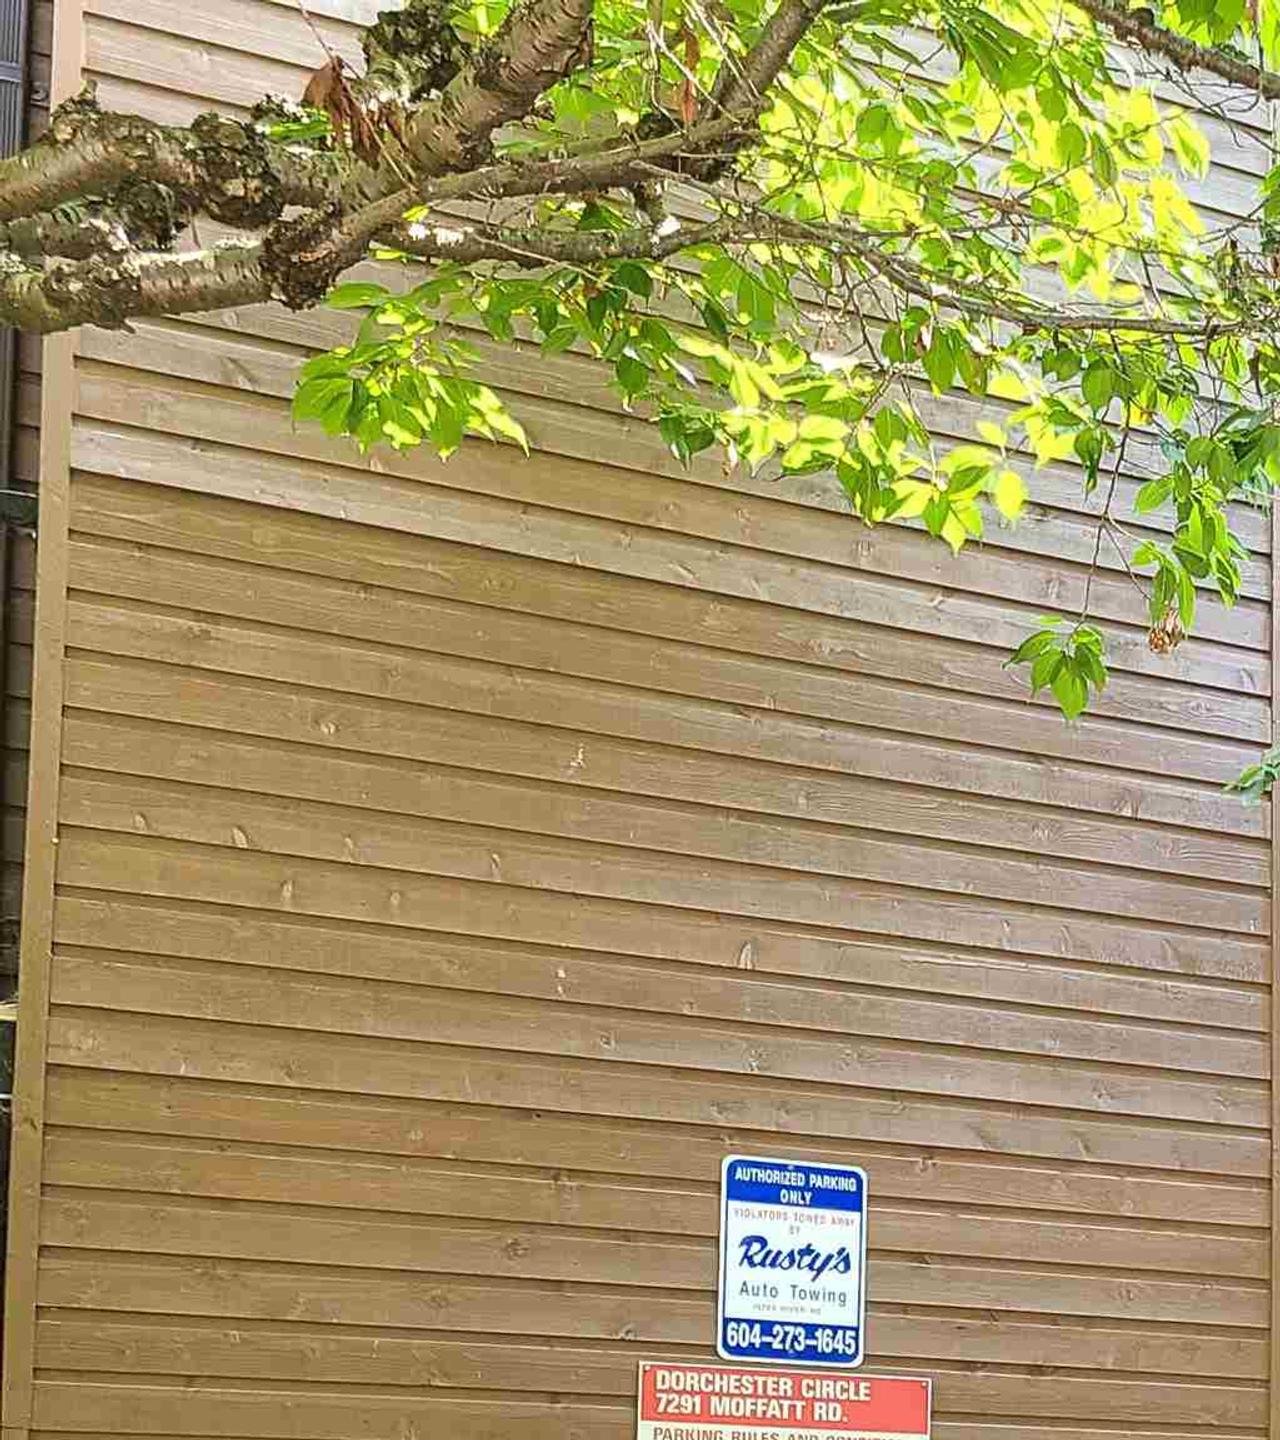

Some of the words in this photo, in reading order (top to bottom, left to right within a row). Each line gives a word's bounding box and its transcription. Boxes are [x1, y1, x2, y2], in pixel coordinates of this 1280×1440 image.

[735, 1166, 805, 1187] AUTHORIZED
[809, 1174, 857, 1192] PARKING
[779, 1191, 812, 1205] ONLY
[738, 1235, 852, 1282] Rusty's
[739, 1280, 779, 1299] Auto
[790, 1284, 848, 1308] Towing
[726, 1322, 857, 1355] 604-273-1645
[656, 1370, 793, 1397] DORCHESTER
[801, 1379, 871, 1401] CIRCLE
[656, 1393, 701, 1415] 7291
[710, 1397, 807, 1420] MOFFATT
[814, 1402, 849, 1422] RD.
